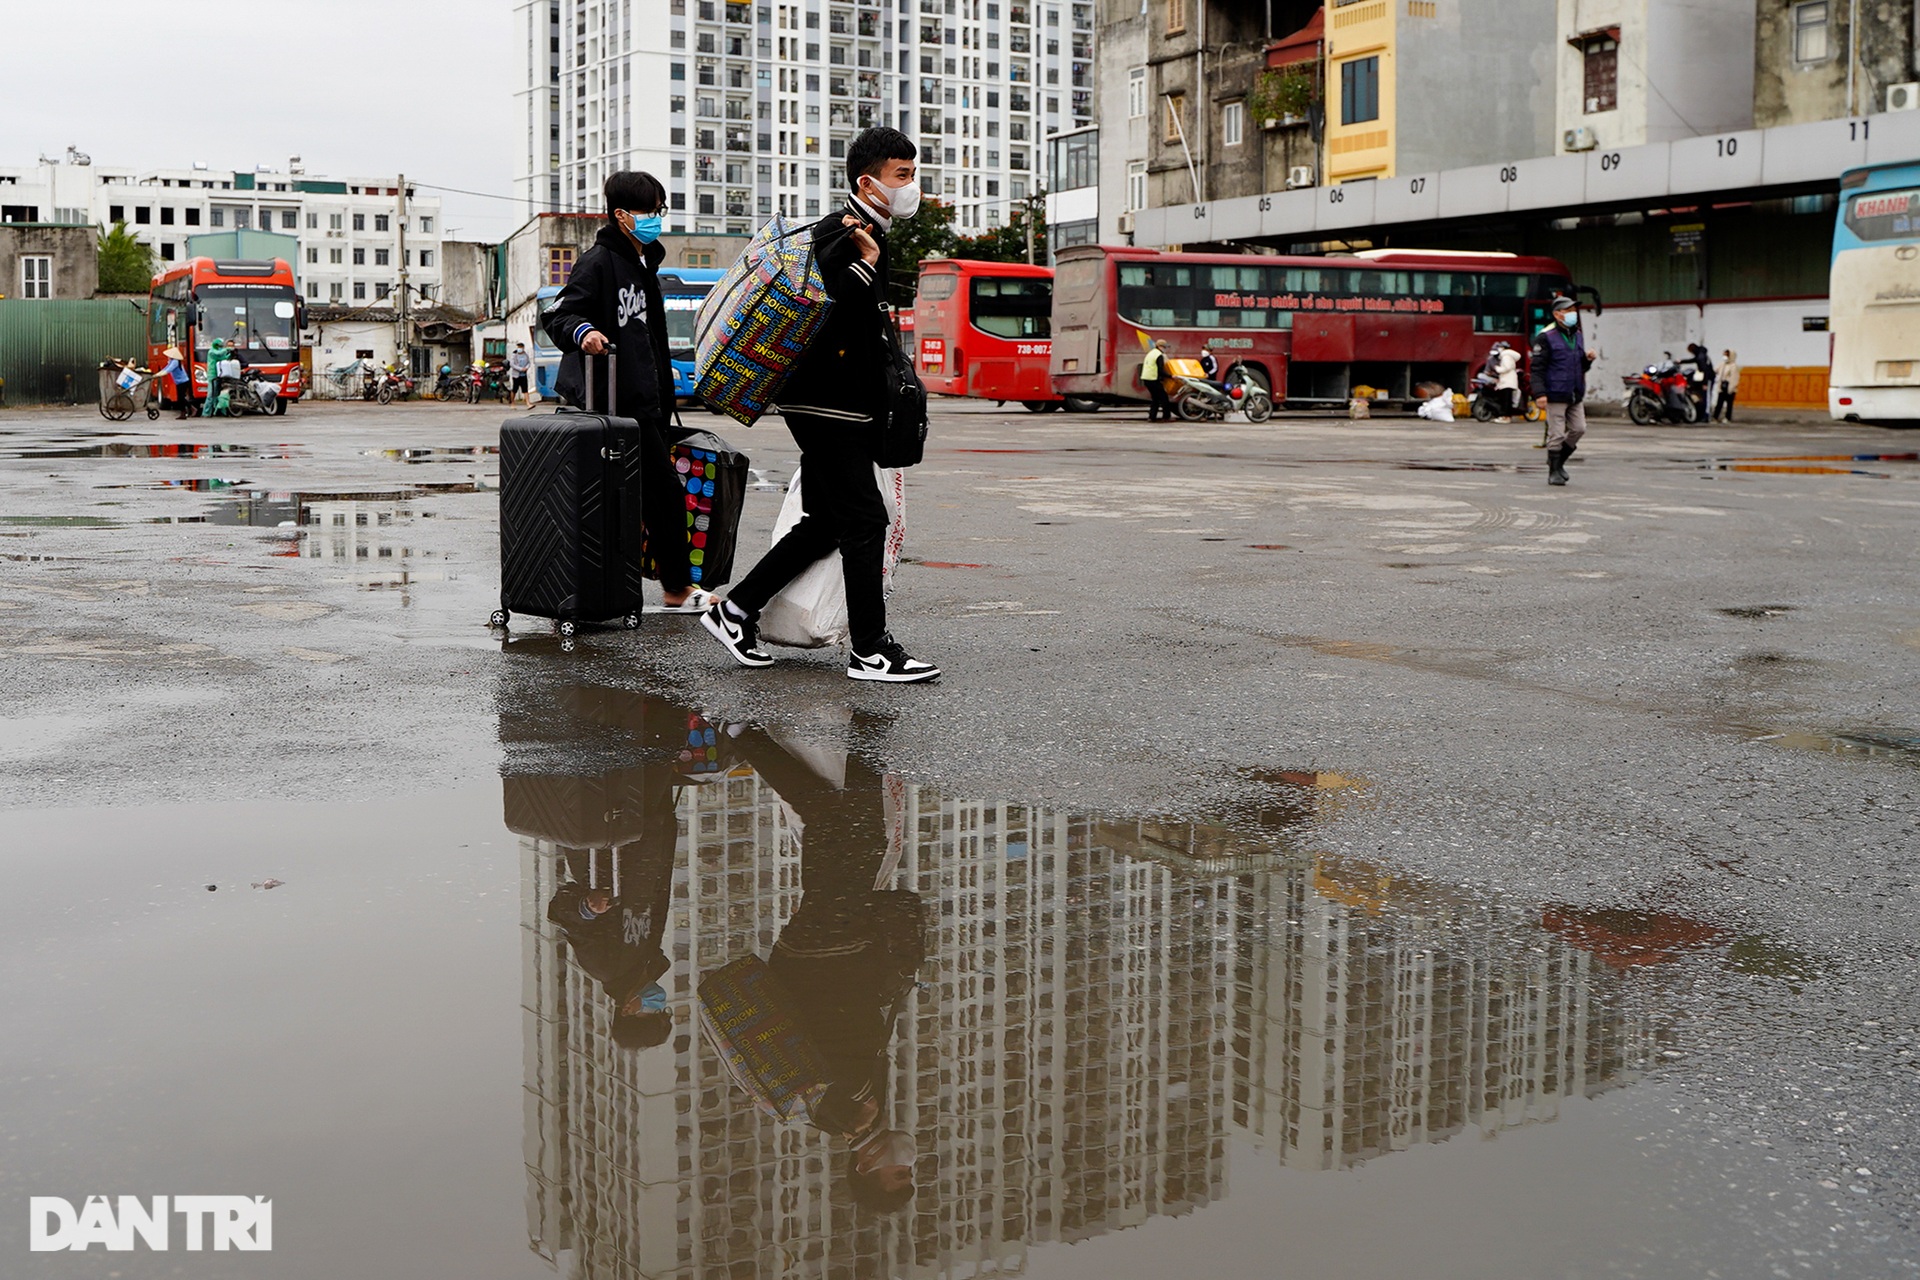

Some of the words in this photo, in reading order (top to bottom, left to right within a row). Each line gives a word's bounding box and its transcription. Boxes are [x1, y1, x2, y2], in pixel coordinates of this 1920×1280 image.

[1849, 120, 1869, 141] 11
[1716, 138, 1737, 157] 10
[1601, 153, 1620, 171] 09
[1500, 166, 1517, 183] 08
[1329, 188, 1344, 204] 06
[1410, 178, 1426, 194] 07
[1194, 206, 1205, 219] 04
[1258, 197, 1271, 212] 05
[1257, 296, 1269, 308] xe
[735, 320, 761, 351] SOIGNE
[764, 316, 790, 348] SOIGNE
[724, 347, 763, 373] SOIGNE
[752, 342, 792, 366] SOIGNE
[719, 354, 758, 380] SOIGNE
[722, 376, 748, 405] SOIGNE
[750, 370, 775, 401] SOIGNE
